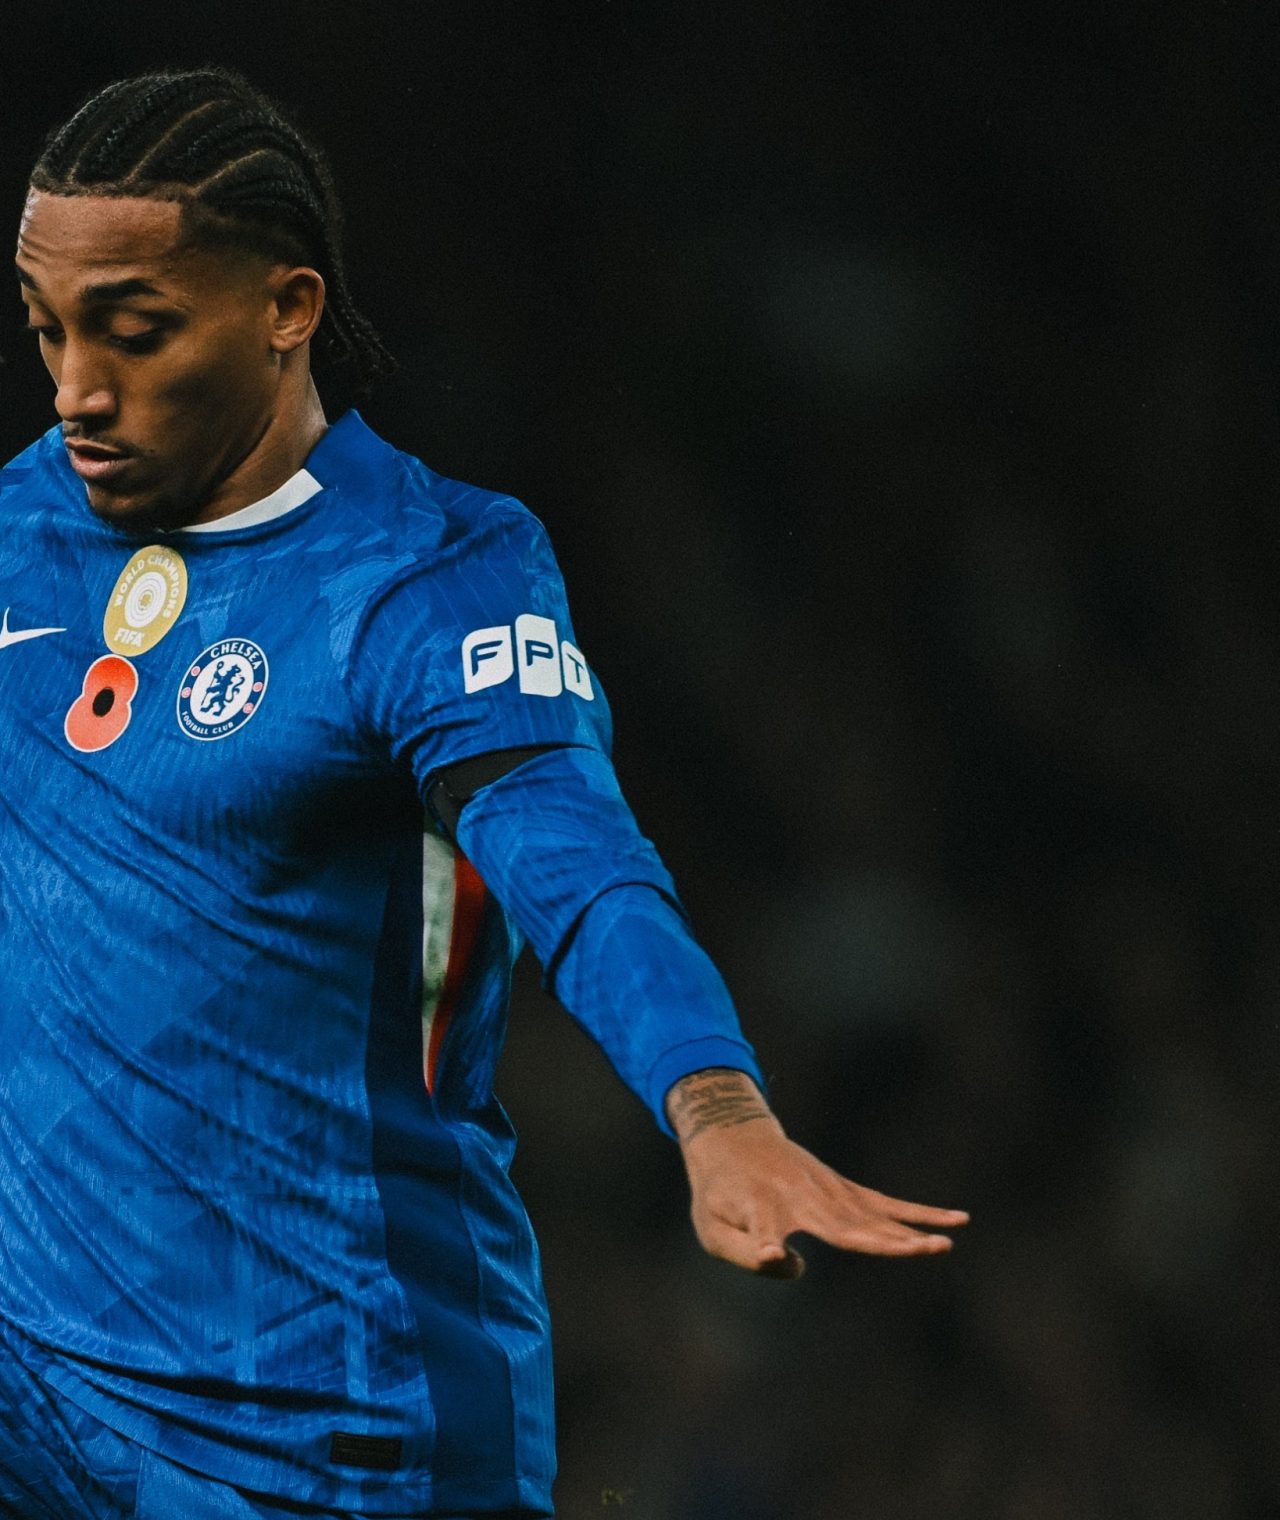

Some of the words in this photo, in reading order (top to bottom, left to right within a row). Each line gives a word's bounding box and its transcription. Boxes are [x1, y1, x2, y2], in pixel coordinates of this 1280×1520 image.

[114, 559, 145, 607] WORLD
[148, 555, 180, 618] CHAMPIONS
[114, 628, 145, 647] FIFA
[210, 643, 263, 670] CHELSEA
[181, 710, 209, 735] FOOTBALL
[212, 721, 235, 735] CLUB
